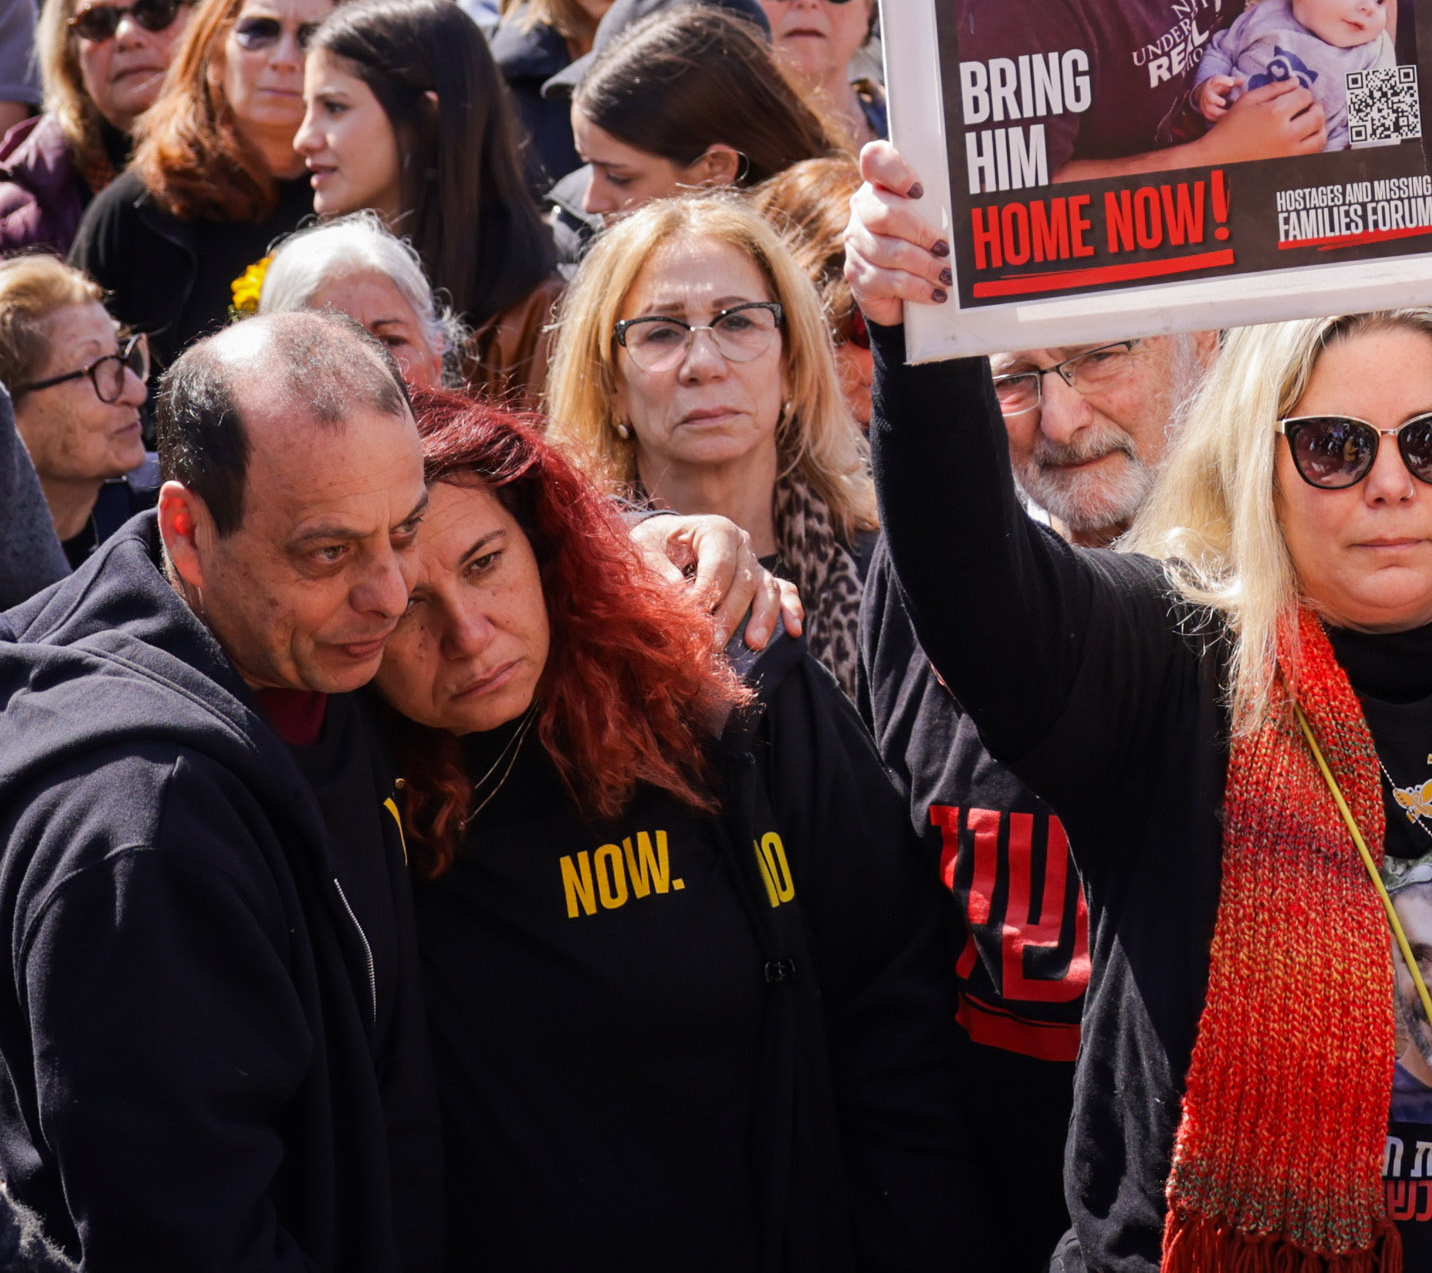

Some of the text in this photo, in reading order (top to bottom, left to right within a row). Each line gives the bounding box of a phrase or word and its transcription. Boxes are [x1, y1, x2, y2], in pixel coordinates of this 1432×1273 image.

[959, 48, 1093, 126] BRING
[964, 123, 1050, 195] HIM
[1276, 175, 1432, 213] HOSTAGES AND MISSING
[971, 169, 1232, 271] HOME NOW!
[1277, 203, 1366, 243] FAMILIES
[560, 830, 685, 918] NOW.
